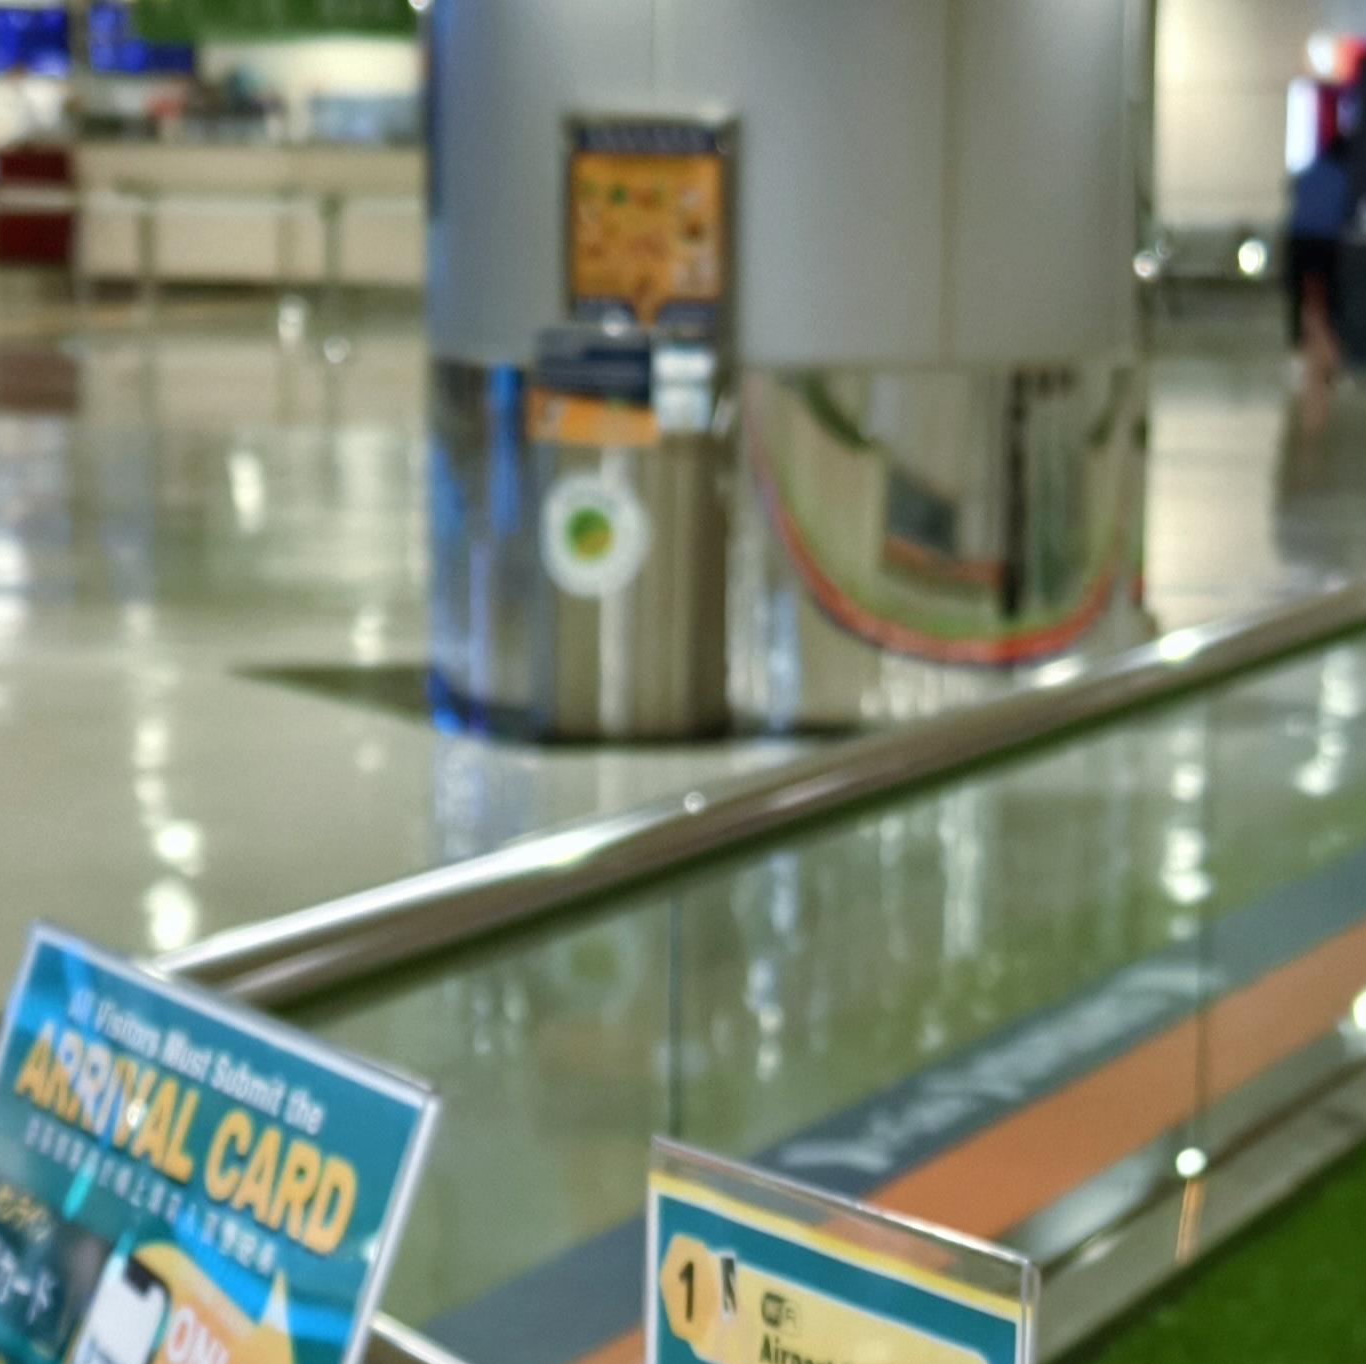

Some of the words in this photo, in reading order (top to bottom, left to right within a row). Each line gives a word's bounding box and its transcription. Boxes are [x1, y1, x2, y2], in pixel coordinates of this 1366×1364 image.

[209, 1052, 287, 1119] Submit
[284, 1087, 325, 1137] the
[15, 1020, 199, 1185] ARRIVAL
[205, 1110, 358, 1256] CARD
[679, 1261, 695, 1323] 1
